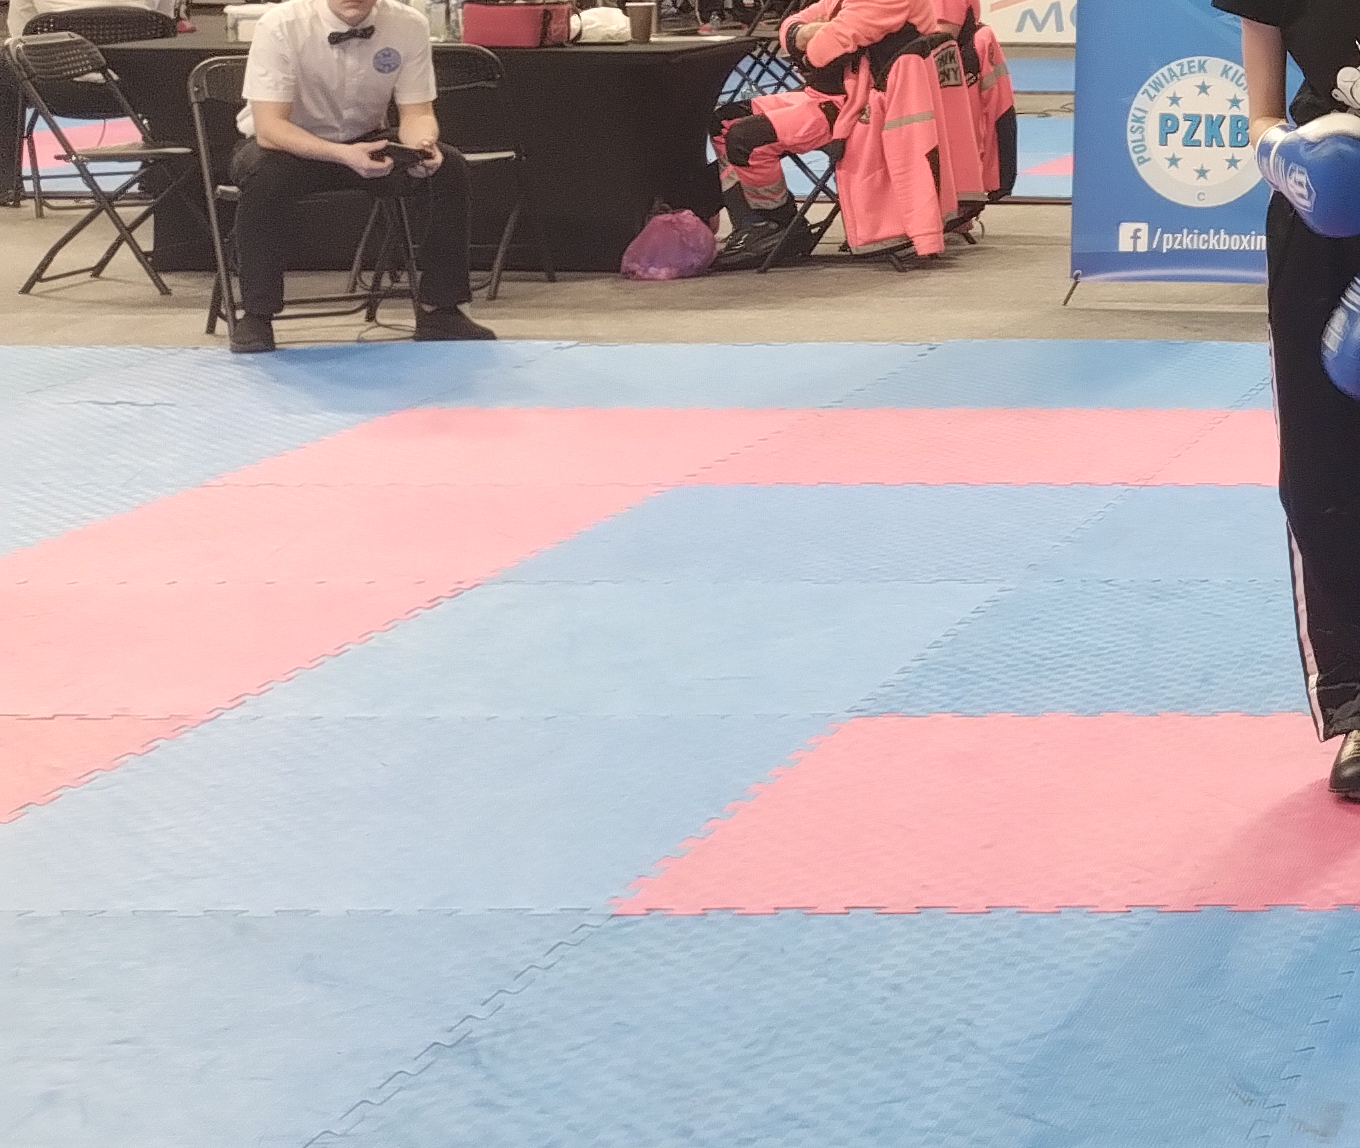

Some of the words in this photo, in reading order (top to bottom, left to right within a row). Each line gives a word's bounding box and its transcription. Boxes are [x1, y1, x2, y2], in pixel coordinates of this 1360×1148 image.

[1129, 105, 1150, 167] POLSKI
[1140, 58, 1209, 102] ZWIĄZEK
[1219, 63, 1248, 94] KIC
[1157, 111, 1250, 148] PZKB
